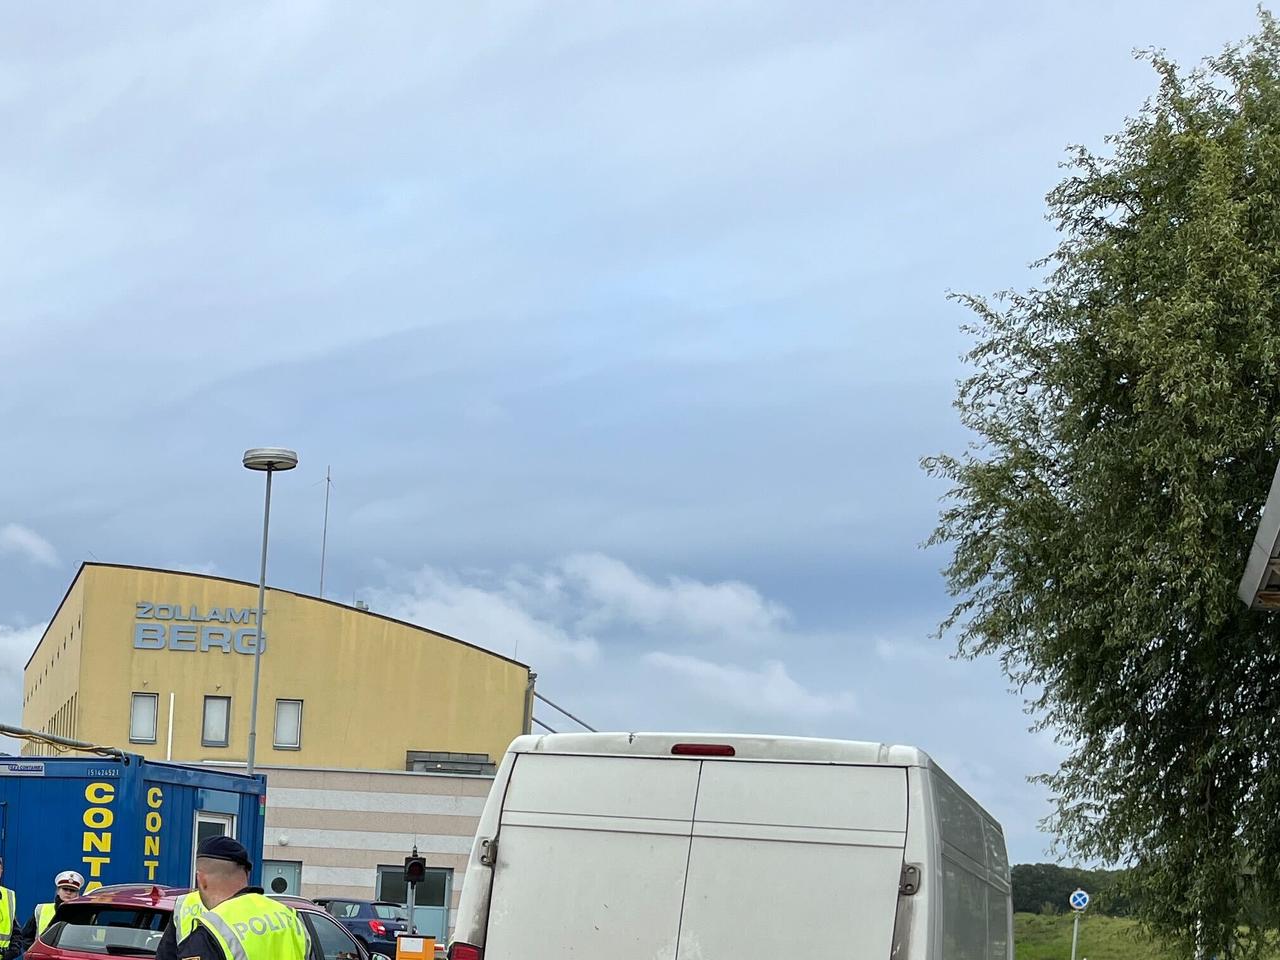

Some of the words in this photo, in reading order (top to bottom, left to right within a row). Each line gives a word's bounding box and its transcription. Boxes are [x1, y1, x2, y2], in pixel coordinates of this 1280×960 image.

[135, 601, 267, 625] ZOLLAMT
[133, 622, 267, 656] BERG
[143, 786, 163, 881] CONT
